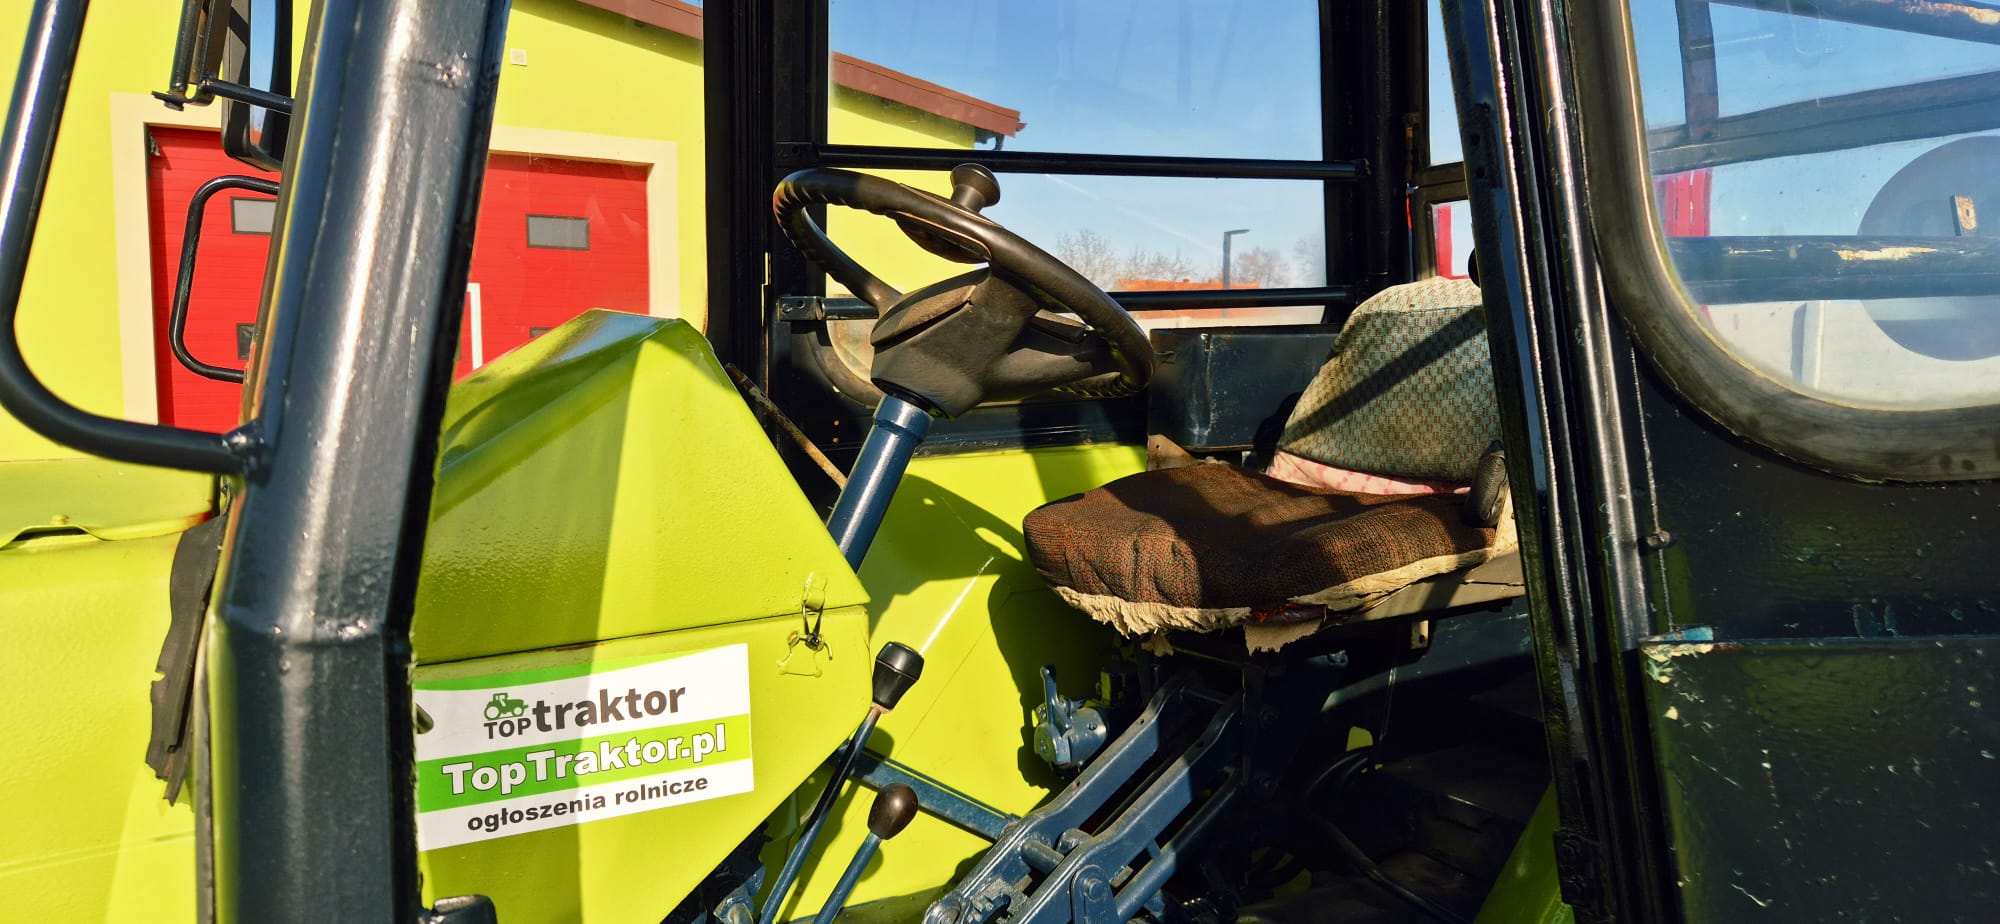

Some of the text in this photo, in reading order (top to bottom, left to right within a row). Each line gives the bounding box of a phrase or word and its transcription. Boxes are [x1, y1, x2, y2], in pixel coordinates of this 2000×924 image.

[484, 687, 686, 740] TOP traktor
[441, 723, 727, 796] TopTraktor.pl
[467, 776, 709, 833] ogłoszenia rolnicze
